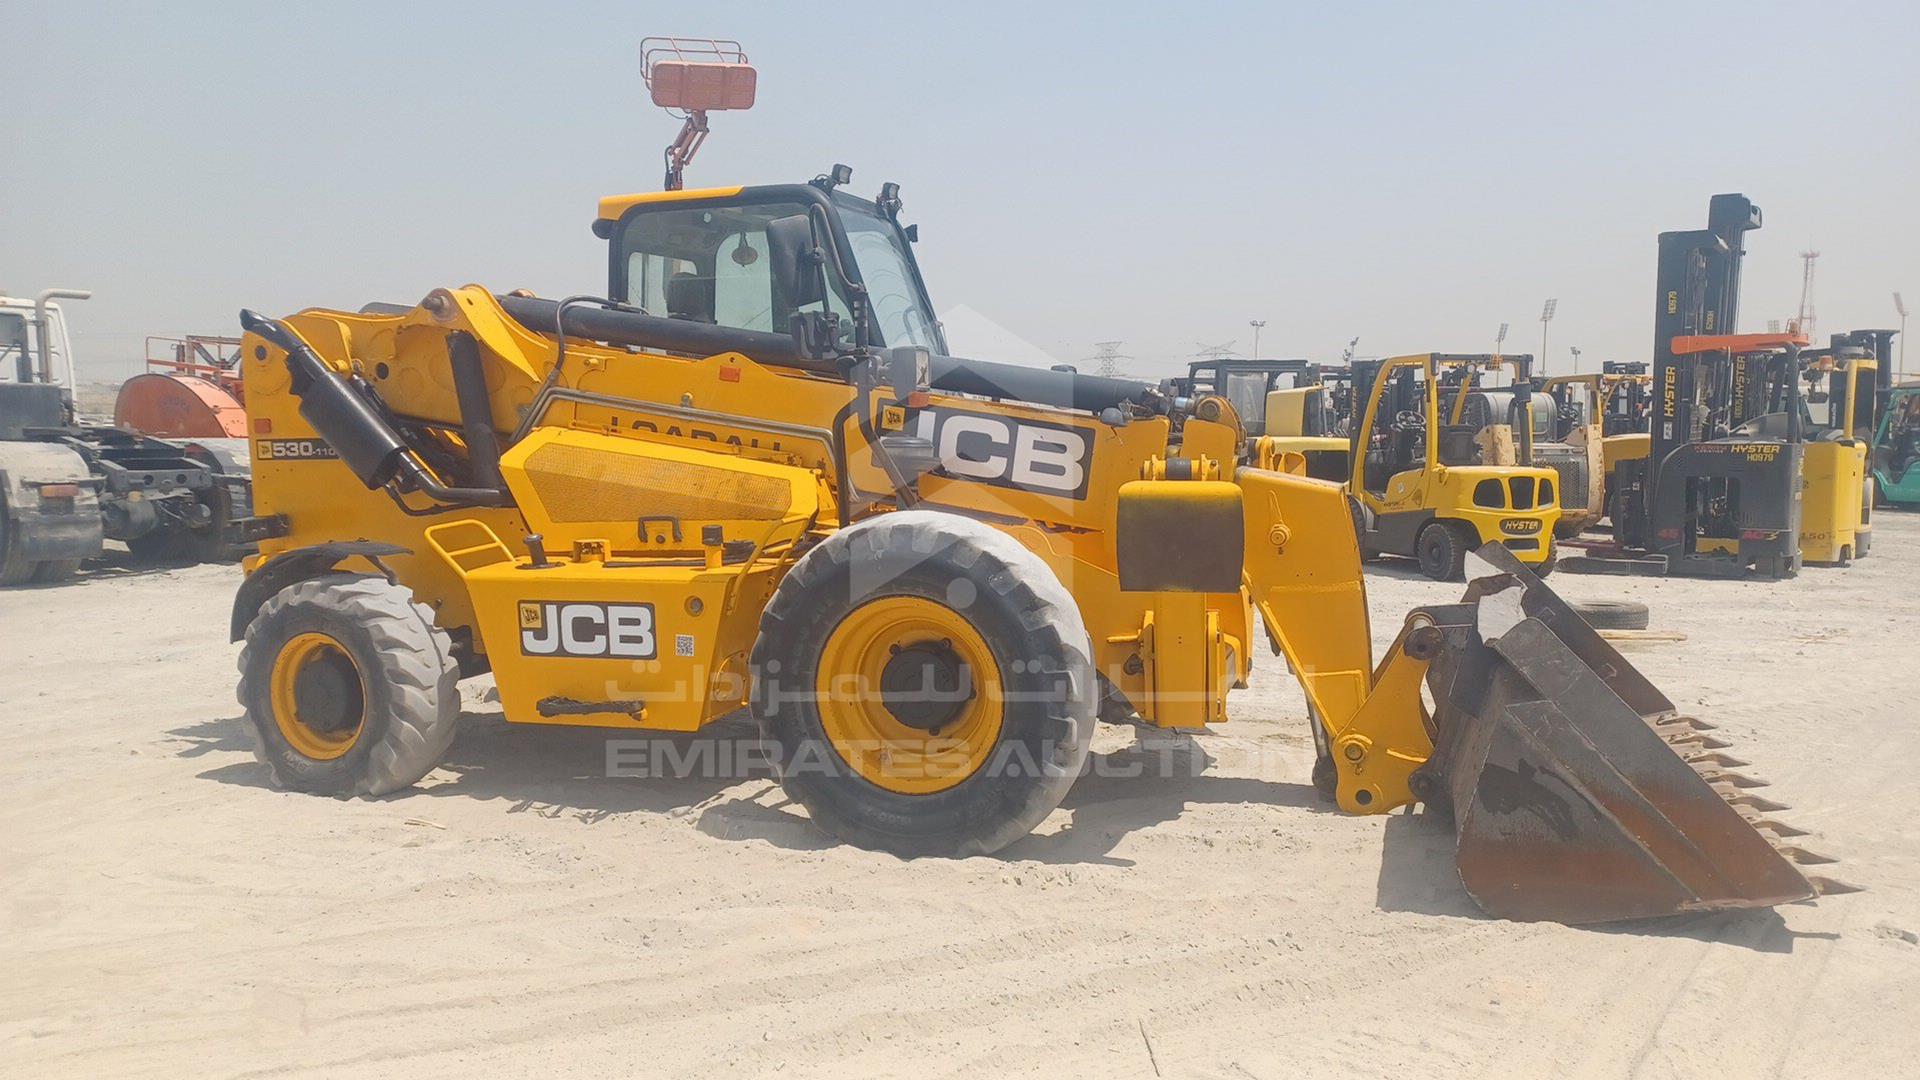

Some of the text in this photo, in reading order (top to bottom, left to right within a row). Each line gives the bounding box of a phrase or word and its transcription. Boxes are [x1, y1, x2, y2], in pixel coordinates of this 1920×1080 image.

[1664, 366, 1675, 417] HYSTER
[1735, 356, 1745, 398] HYSTER
[1731, 445, 1780, 454] HYSTER
[1505, 520, 1538, 530] HYSTER
[522, 604, 654, 656] JCB
